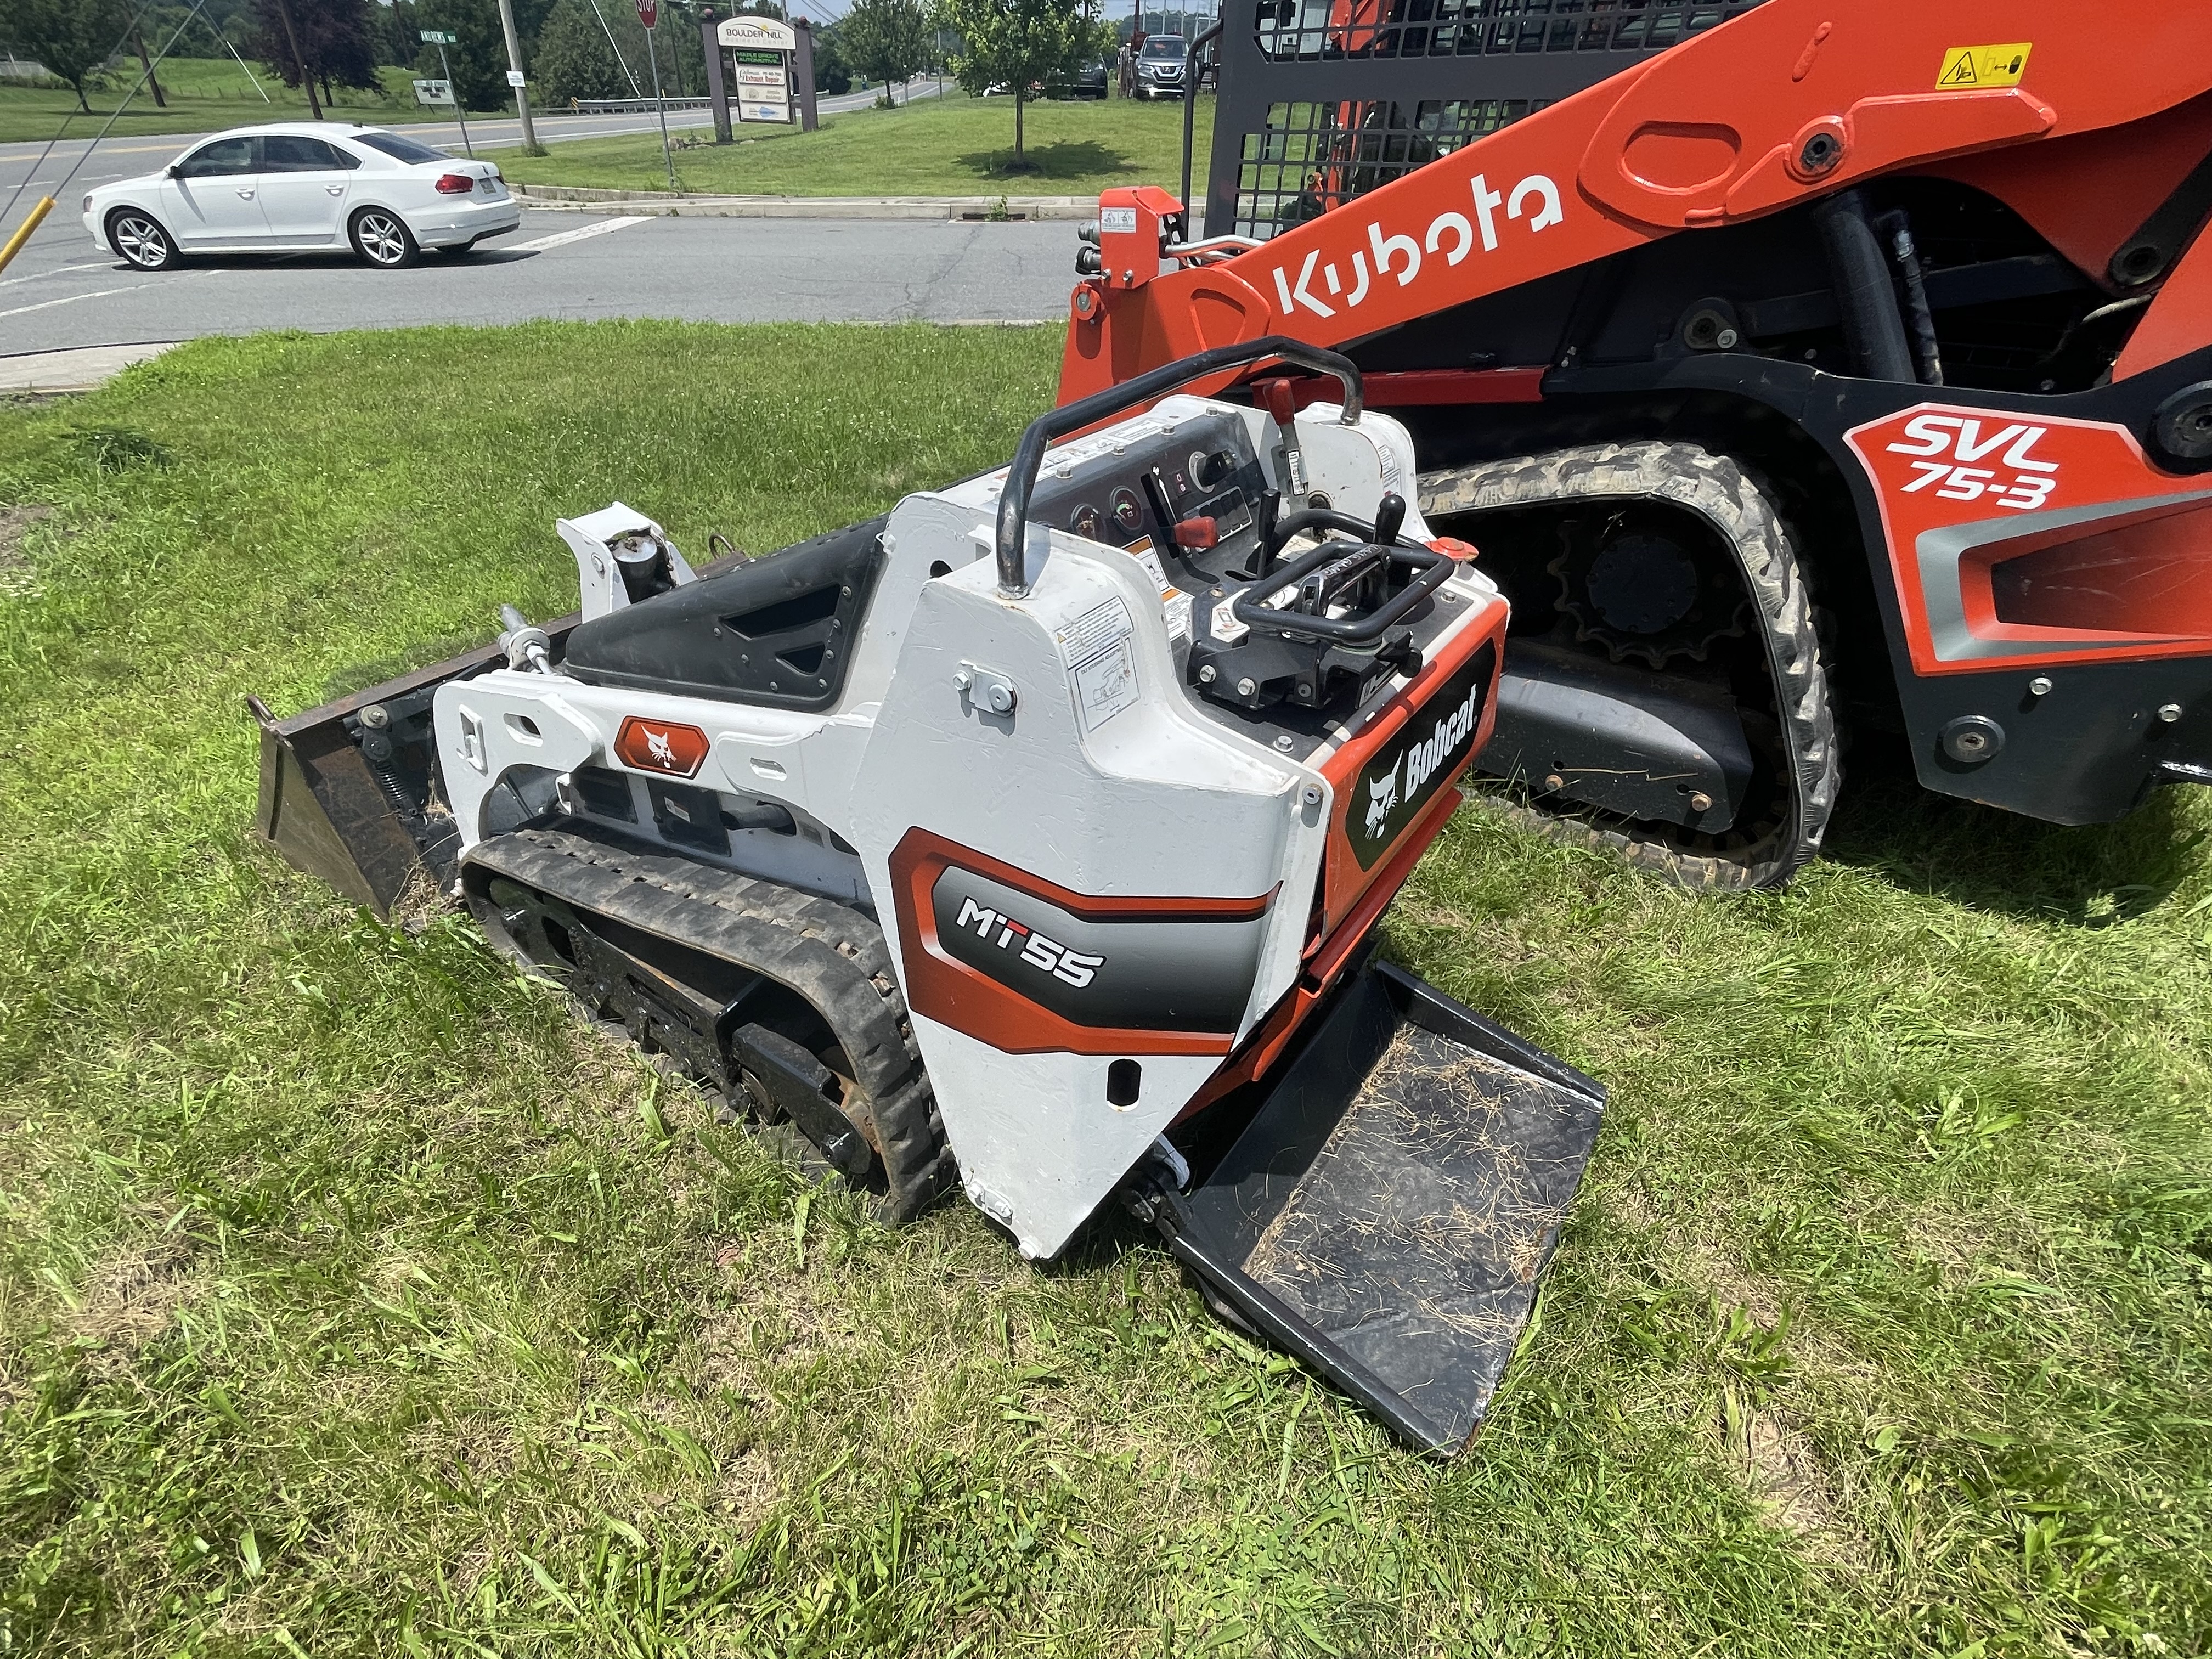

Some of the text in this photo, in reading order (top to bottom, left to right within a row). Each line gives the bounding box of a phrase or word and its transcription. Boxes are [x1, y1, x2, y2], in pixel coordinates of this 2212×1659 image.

[726, 29, 782, 40] BOULDER HILL
[1272, 173, 1564, 318] Kubota
[1885, 415, 2059, 472] SVL
[1900, 461, 2057, 509] 75-3
[1405, 684, 1476, 803] Bobcat
[956, 897, 1104, 988] MT55
